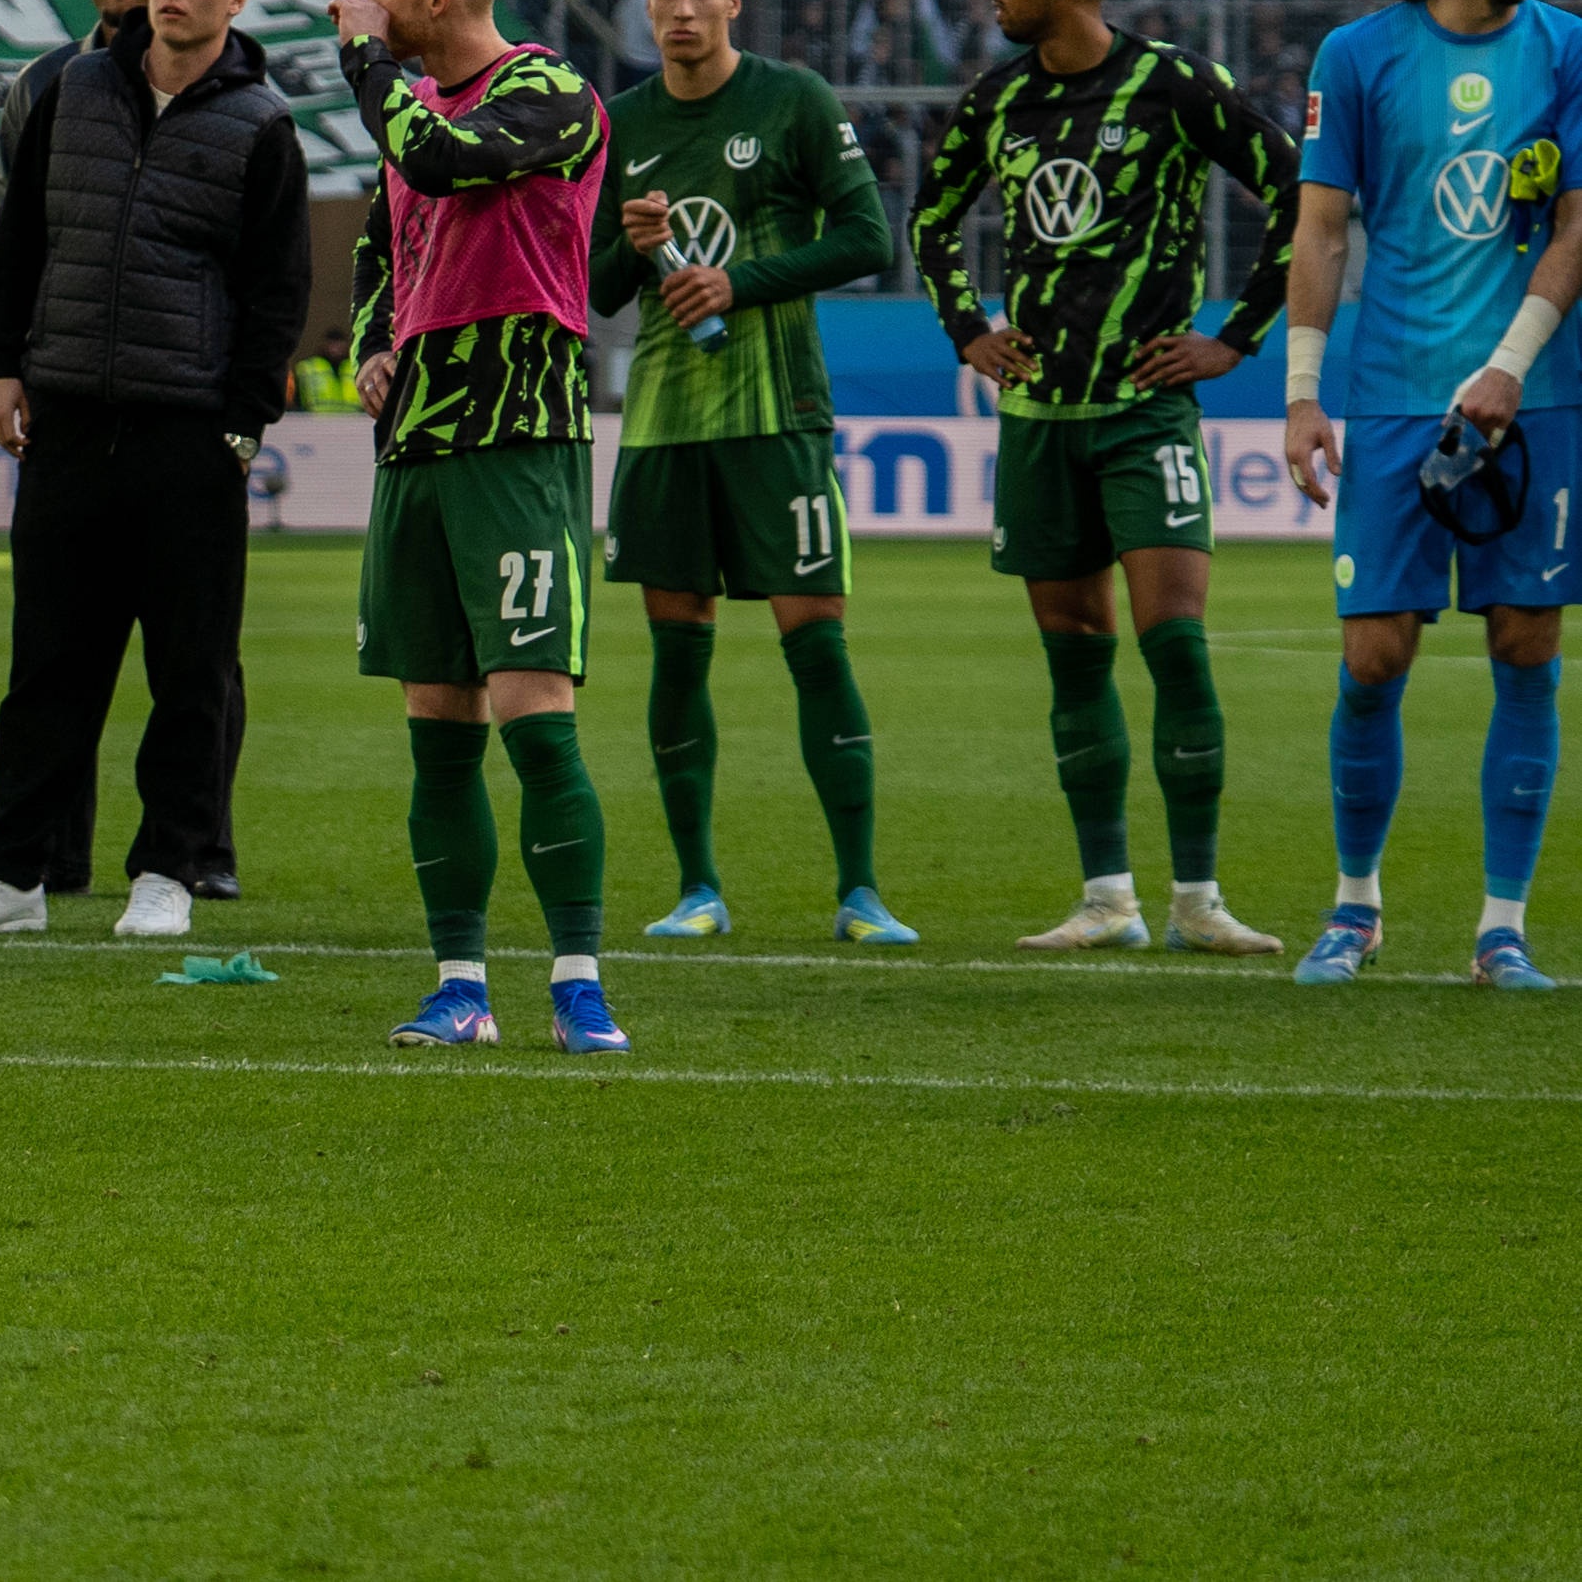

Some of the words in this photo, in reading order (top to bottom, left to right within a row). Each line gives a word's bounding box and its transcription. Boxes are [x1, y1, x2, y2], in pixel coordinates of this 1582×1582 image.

[1154, 444, 1201, 504] 15
[788, 494, 832, 556] 11
[1553, 488, 1570, 550] 1
[500, 549, 554, 620] 27
